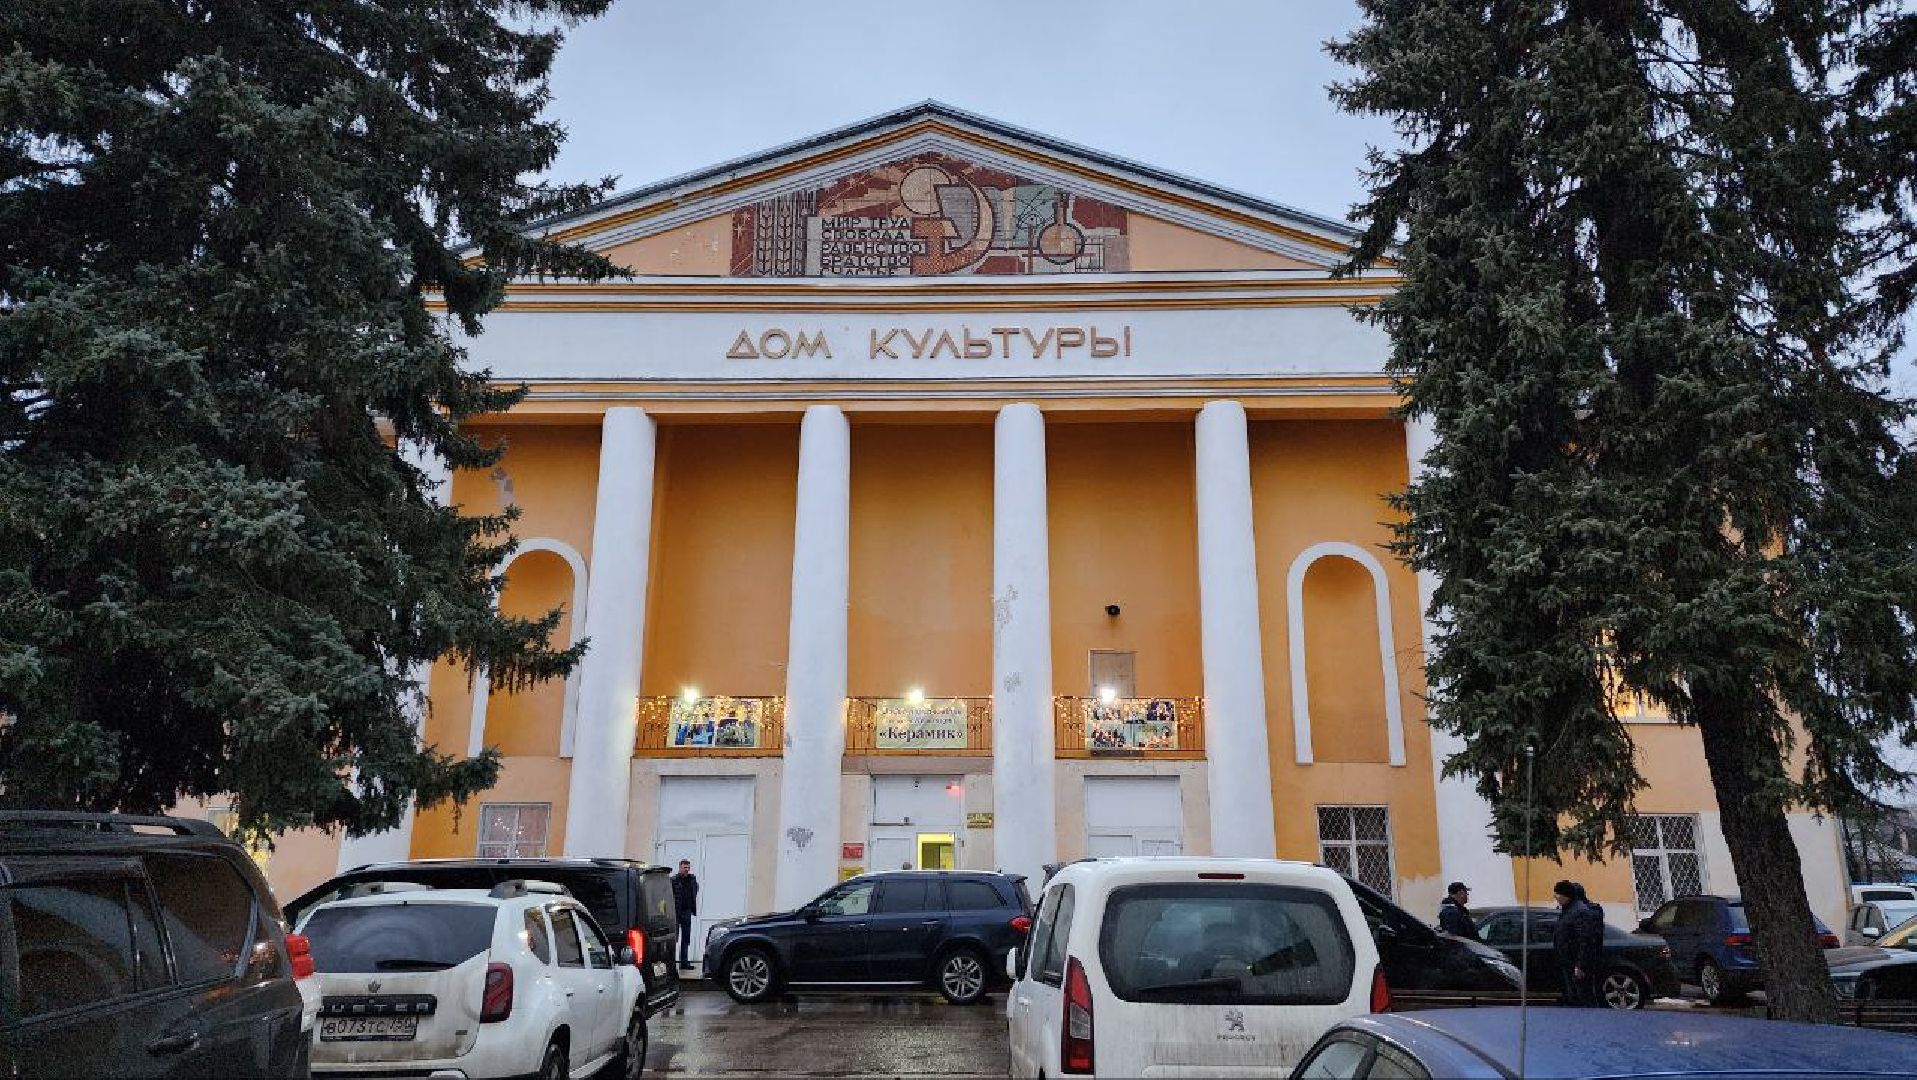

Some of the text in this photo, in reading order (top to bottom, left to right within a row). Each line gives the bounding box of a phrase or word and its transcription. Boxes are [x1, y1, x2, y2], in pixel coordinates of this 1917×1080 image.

[822, 217, 860, 228] МИР
[821, 229, 904, 240] СВОБОДА
[821, 242, 923, 254] РАВЕНСТВО
[821, 255, 910, 266] БРАТСТВО
[726, 325, 1131, 359] ДОМ КУЛЬТУРЫ
[879, 727, 963, 742] «Керамик»
